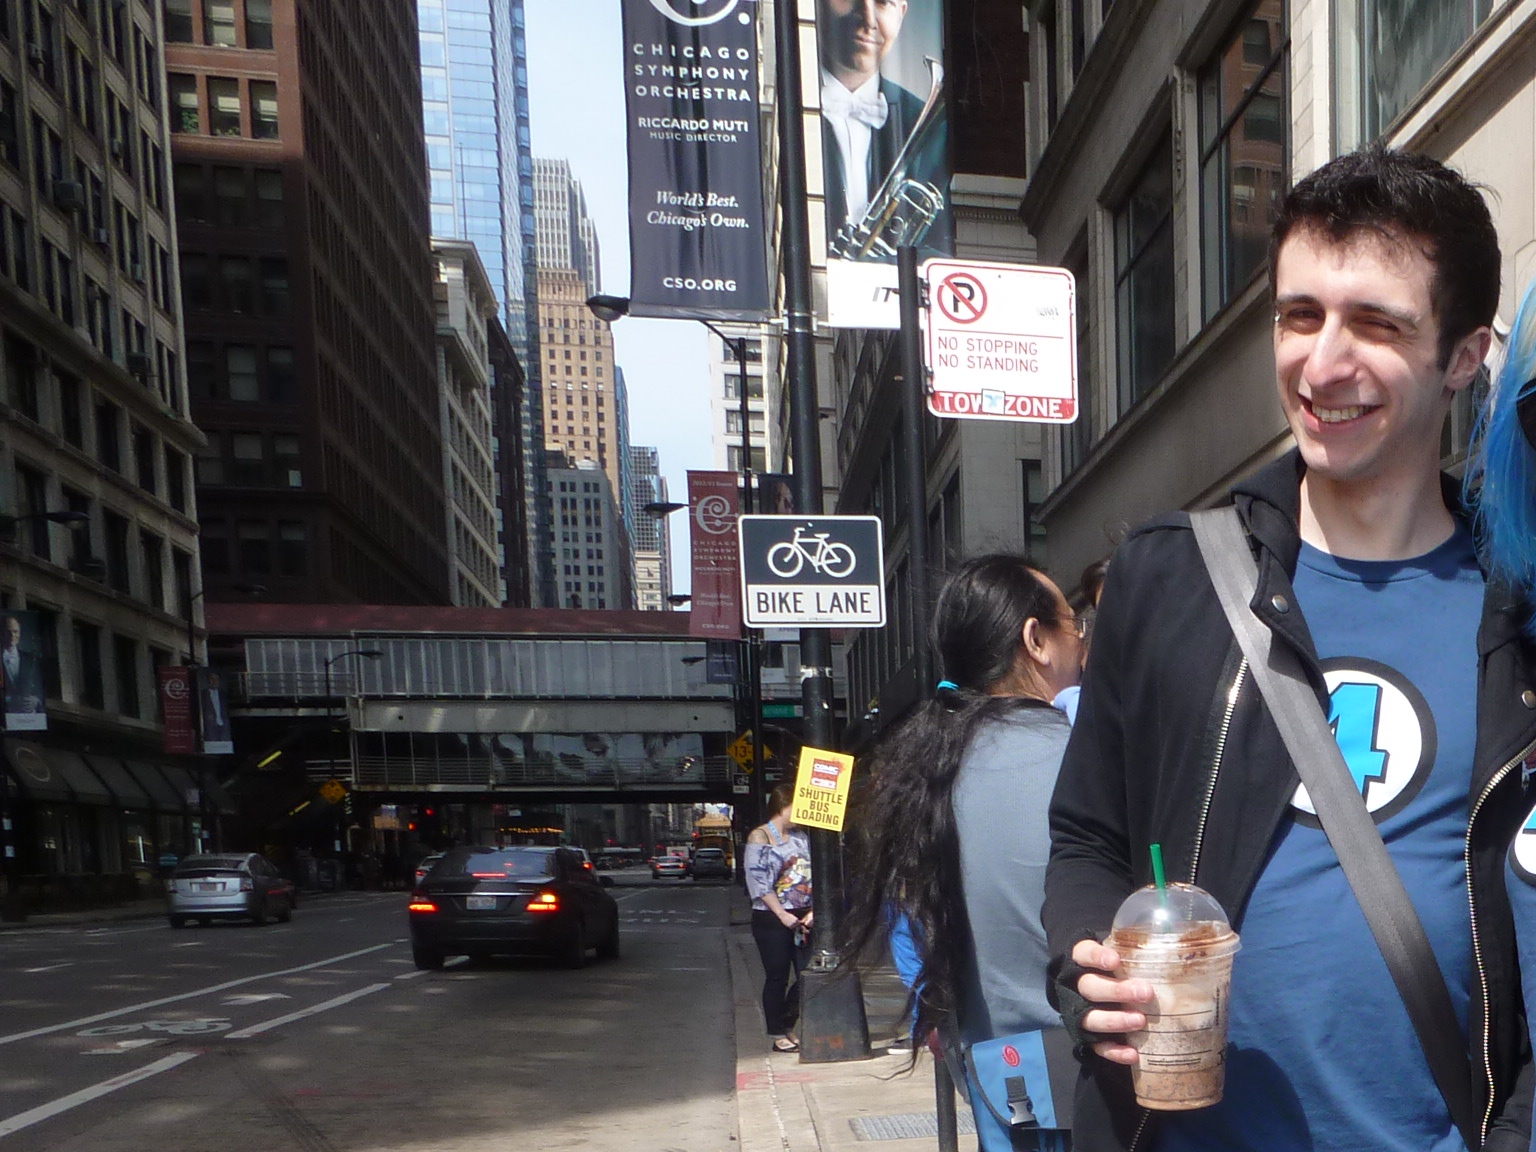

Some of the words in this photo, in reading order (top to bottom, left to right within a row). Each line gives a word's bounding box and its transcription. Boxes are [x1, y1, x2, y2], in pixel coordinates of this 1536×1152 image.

[633, 43, 749, 60] CHICAGO
[634, 64, 750, 81] SYMPHONY
[635, 85, 751, 101] ORCHESTRA
[638, 117, 709, 132] RICCARDO
[713, 120, 749, 132] MUTI
[650, 132, 681, 141] MUSIC
[686, 133, 737, 143] DIRECTOR
[656, 191, 704, 207] World's
[707, 194, 739, 208] Best.
[710, 213, 750, 229] Own.
[663, 277, 737, 292] CSO.ORG
[938, 336, 958, 350] NO
[966, 338, 1038, 356] STOPPING
[938, 354, 959, 368] NO
[967, 356, 1039, 373] STANDING
[1004, 396, 1063, 418] ZONE
[756, 591, 805, 613] BIKE
[815, 591, 872, 613] LANE
[799, 787, 844, 805] SHUTTLE
[809, 800, 830, 813] BUS
[796, 808, 840, 826] LOADING
